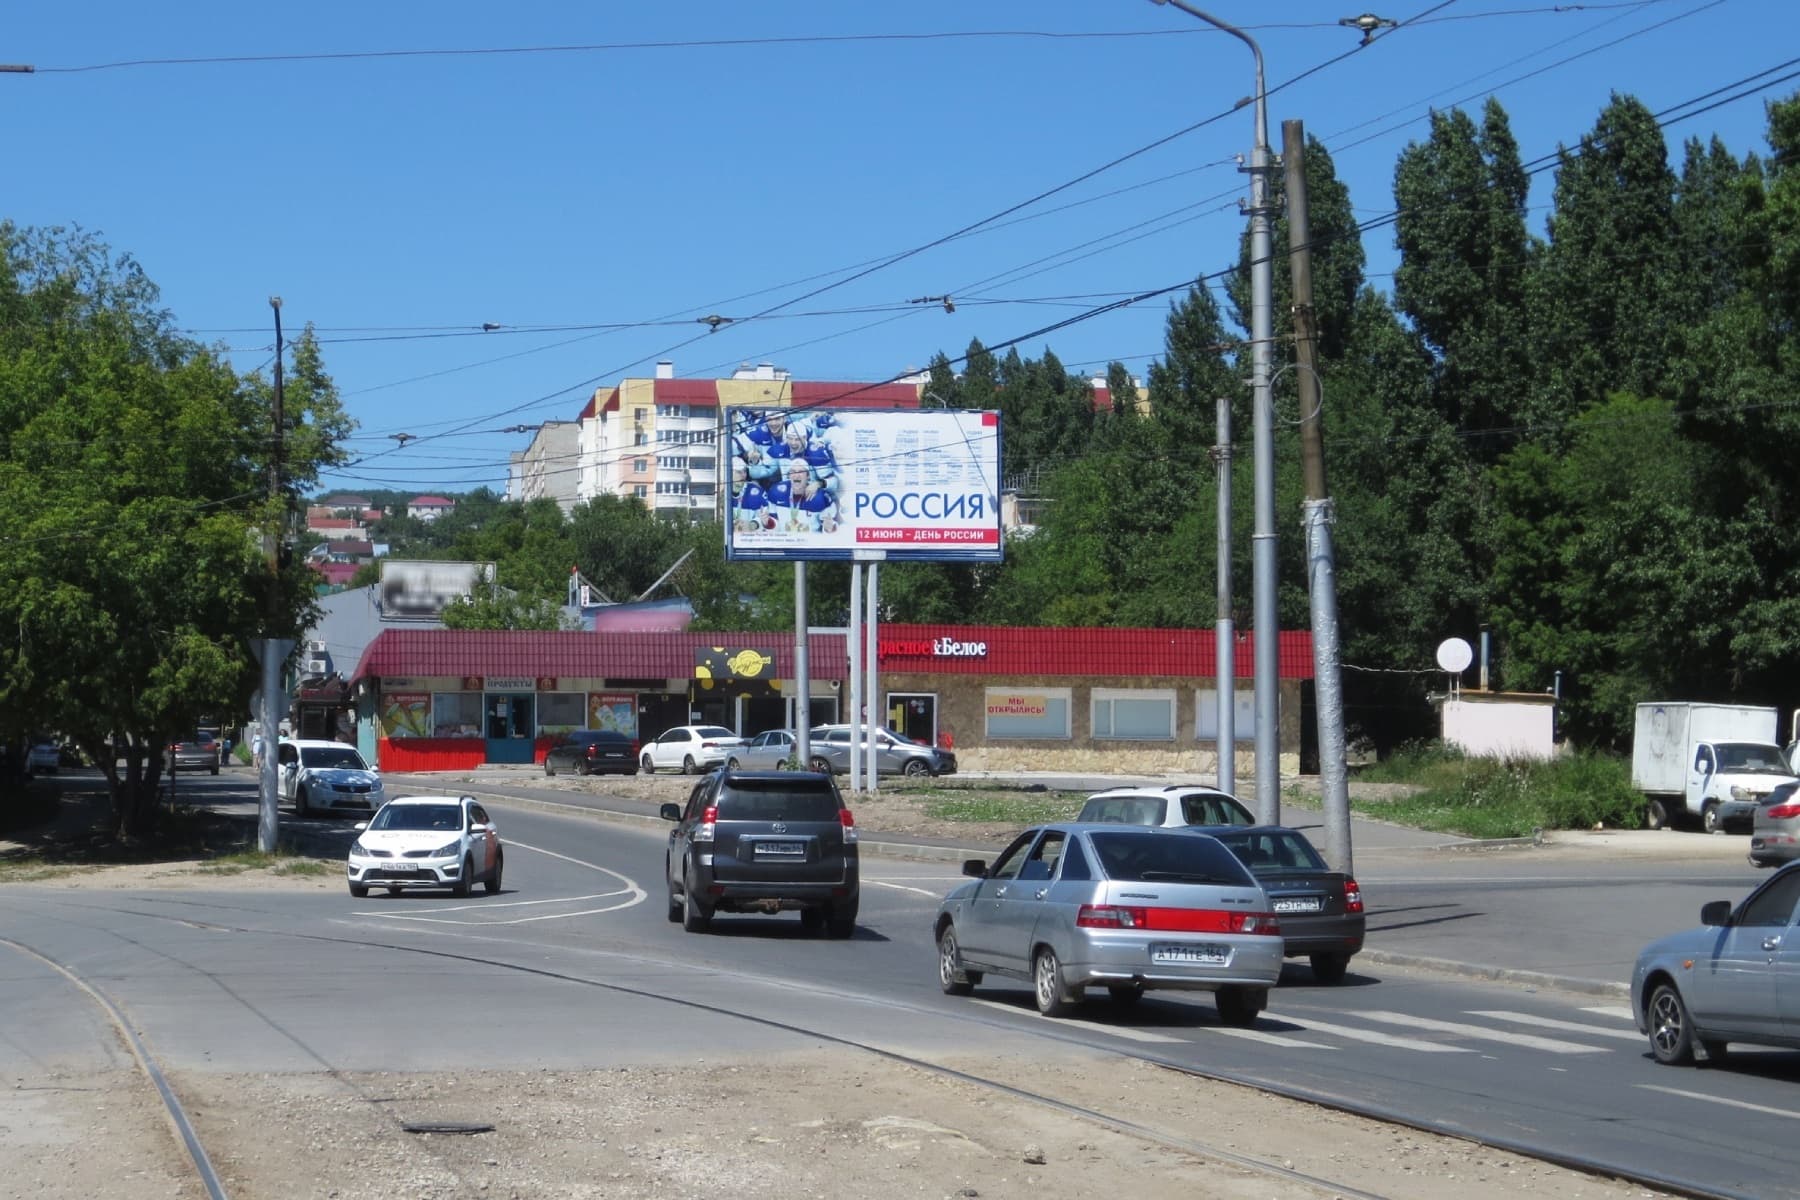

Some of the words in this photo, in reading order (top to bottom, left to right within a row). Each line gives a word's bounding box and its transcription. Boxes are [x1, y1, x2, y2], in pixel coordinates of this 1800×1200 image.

[855, 492, 984, 519] РОССИЯ
[858, 530, 870, 539] 12
[872, 530, 903, 539] ИЮНЯ
[913, 530, 942, 540] ДЕНЬ
[943, 530, 984, 540] РОССИИ
[487, 679, 532, 688] ПРОДУКТЫ
[1008, 697, 1025, 705] МЫ
[987, 706, 1045, 714] ОТКРЫЛИСЬ!
